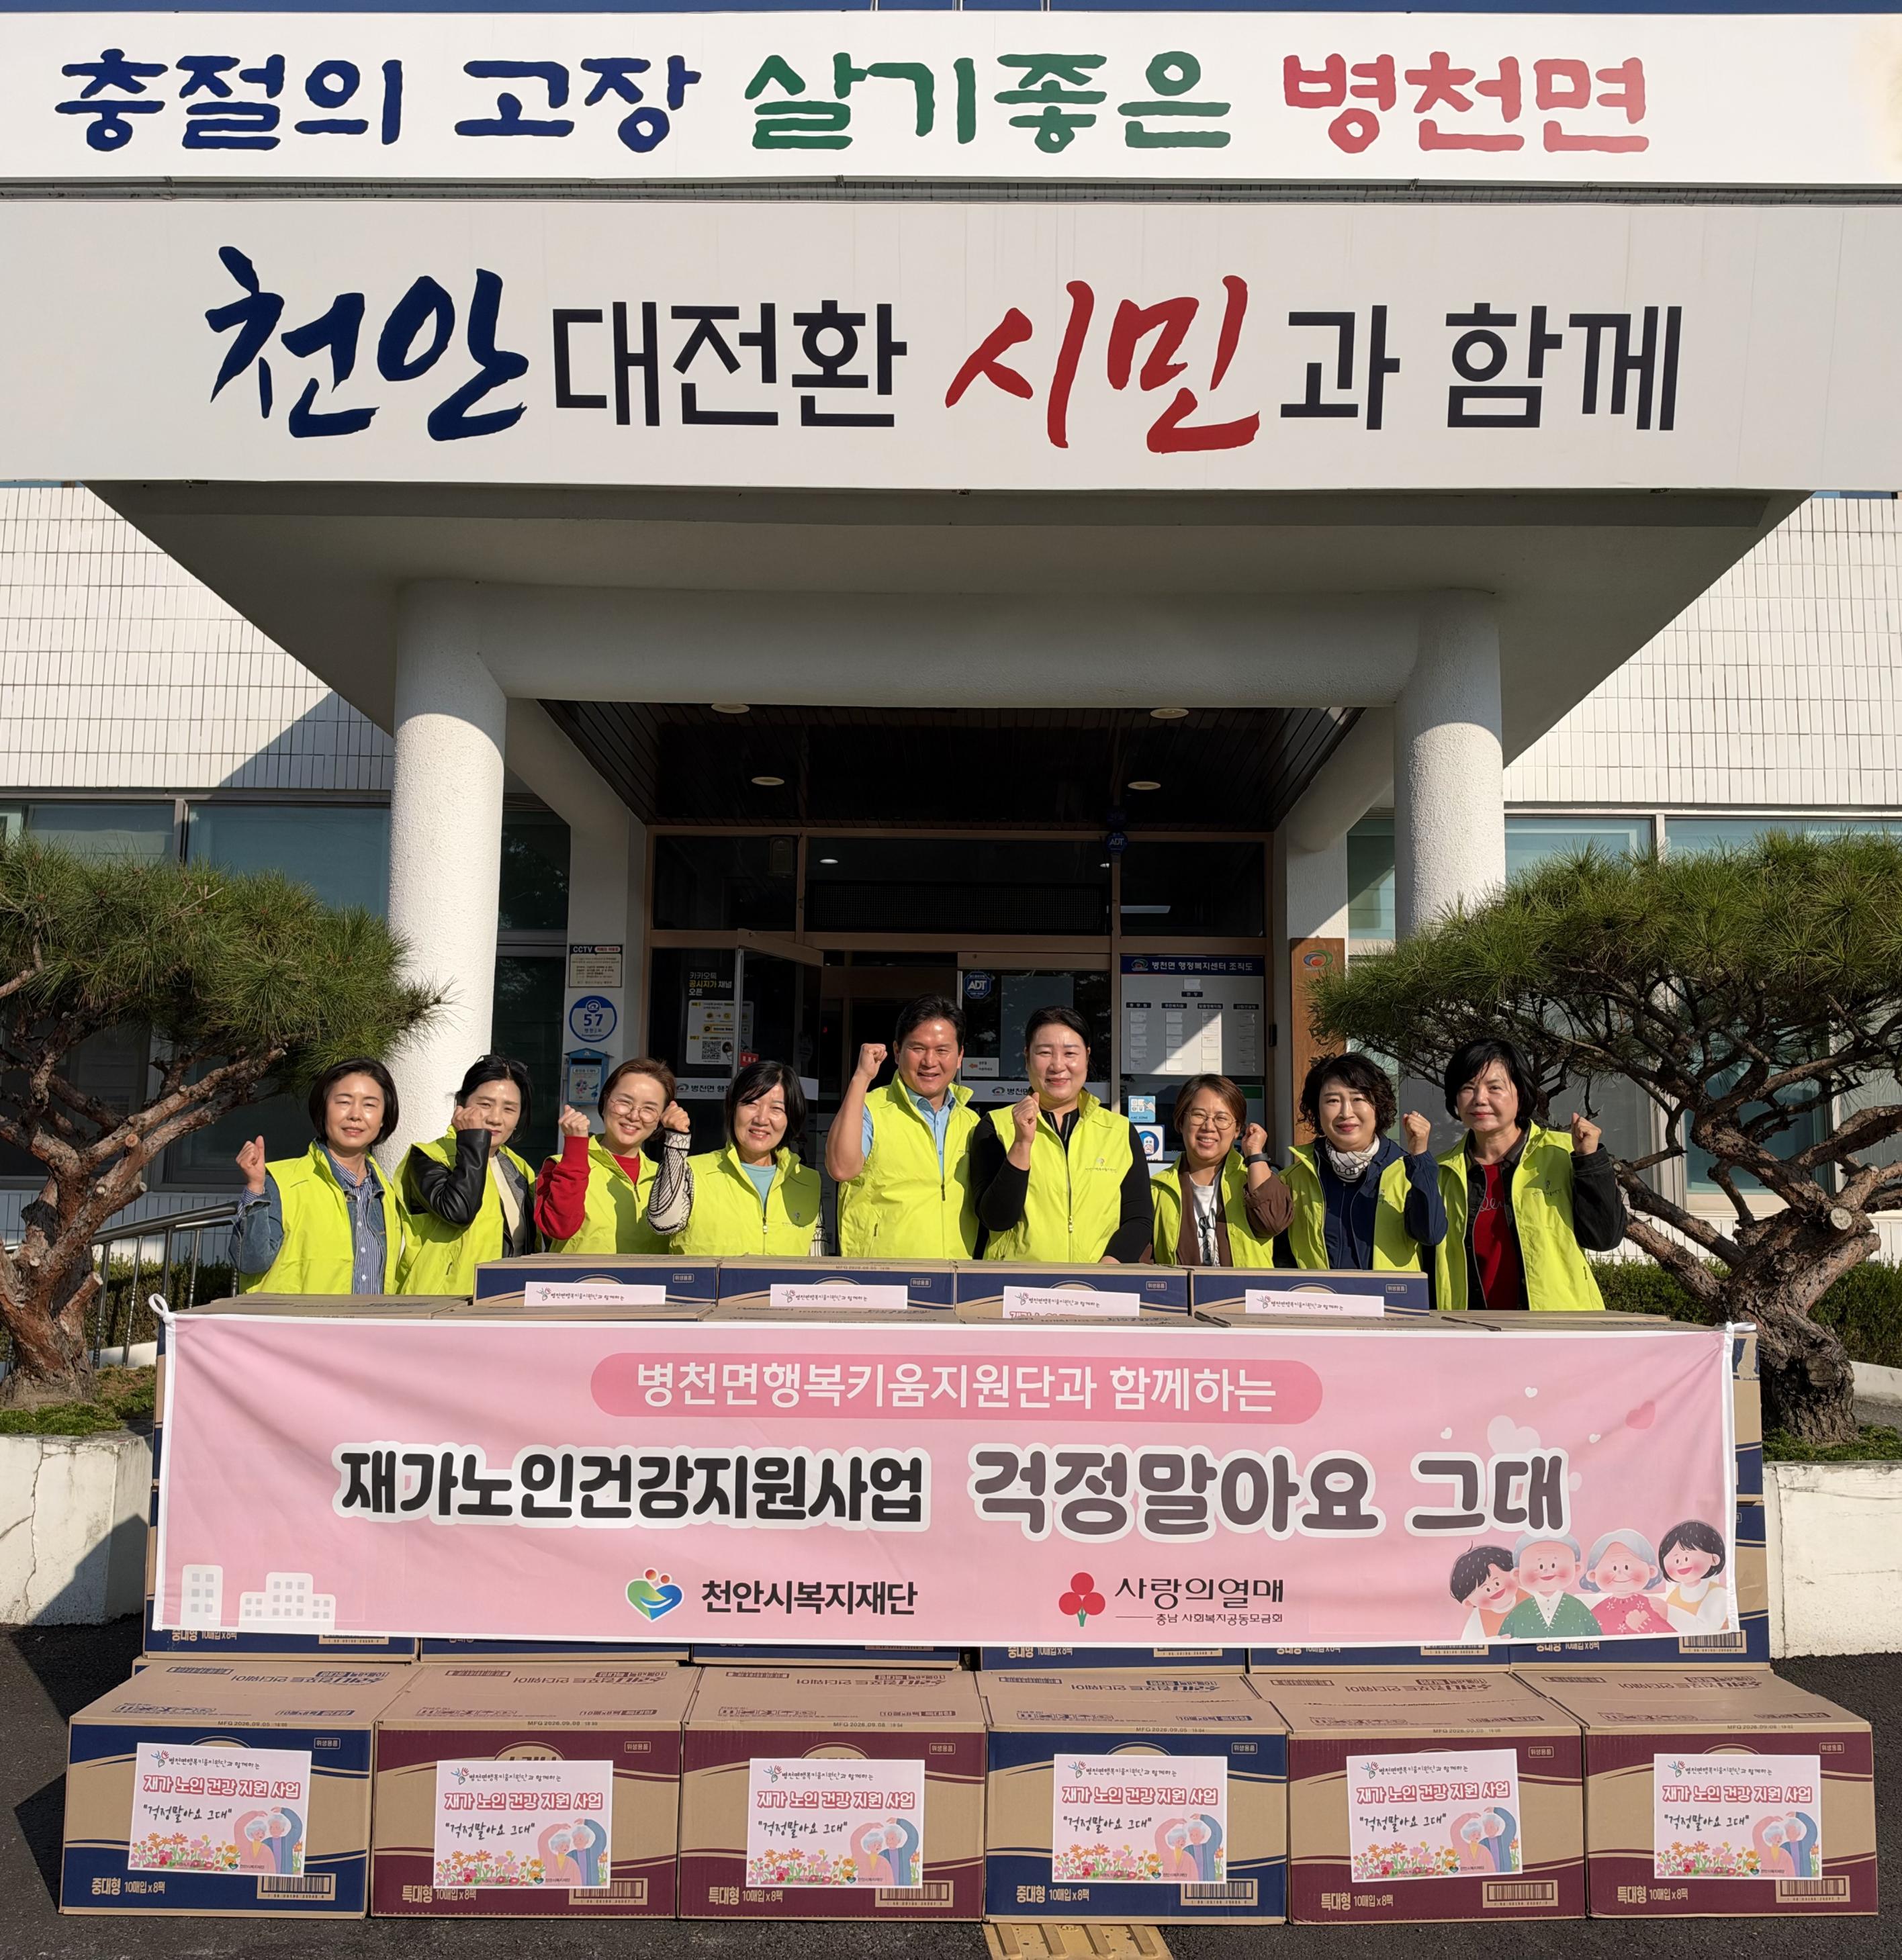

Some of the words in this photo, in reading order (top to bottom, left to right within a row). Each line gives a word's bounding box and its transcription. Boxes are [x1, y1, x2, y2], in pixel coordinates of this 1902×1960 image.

[55, 49, 403, 152] 충절의
[455, 56, 702, 153] 고장
[745, 52, 1231, 154] 살기좋은
[1284, 52, 1643, 154] 병천면
[945, 275, 1400, 455] 시민과
[1446, 303, 1682, 431] 함께
[1110, 838, 1124, 846] ADT
[689, 972, 717, 980] 카카오톡
[1152, 962, 1175, 970] 병천면
[1178, 962, 1226, 971] 행정복지센터
[1229, 962, 1253, 971] 조직도
[688, 980, 717, 988] 공시지가
[718, 980, 732, 988] 채널
[688, 988, 703, 996] 오픈
[967, 980, 987, 990] ADT
[584, 1013, 604, 1027] 57
[638, 1362, 1097, 1409] 병천면행복키움지원단과
[1109, 1366, 1276, 1412] 함께하는
[341, 1450, 922, 1522] 재가노인건강지원사업
[975, 1451, 1378, 1535] 걱정말아요
[1412, 1454, 1563, 1530] 그대
[702, 1580, 918, 1615] 천안시복지재단
[1115, 1578, 1283, 1610] 사랑의열매
[1156, 1614, 1178, 1626] 충남
[1182, 1613, 1283, 1626] 사회복지공동모금회
[316, 1739, 338, 1747] 위생용품
[1233, 1744, 1255, 1753] 위생용품
[142, 1775, 172, 1793] 재가
[175, 1777, 204, 1795] 노인
[207, 1778, 236, 1797] 건강
[238, 1780, 268, 1798] 지원
[271, 1781, 301, 1800] 사업
[1062, 1786, 1091, 1804] 재가
[1093, 1787, 1123, 1804] 노인
[1126, 1787, 1155, 1804] 건강
[1158, 1788, 1187, 1805] 지원
[1189, 1788, 1218, 1806] 사업
[1357, 1786, 1386, 1804] 재가
[1388, 1785, 1416, 1803] 노인
[1419, 1783, 1448, 1802] 건강
[1451, 1782, 1480, 1800] 지원
[1482, 1781, 1510, 1798] 사업
[1662, 1785, 1691, 1802] 재가
[1693, 1785, 1721, 1802] 노인
[1724, 1786, 1752, 1803] 건강
[1754, 1786, 1782, 1803] 지원
[1785, 1786, 1813, 1804] 사업
[445, 1792, 473, 1810] 재가
[477, 1792, 506, 1810] 노인
[509, 1792, 538, 1810] 건강
[541, 1792, 570, 1810] 지원
[573, 1792, 603, 1810] 사업
[758, 1791, 787, 1808] 재가
[790, 1791, 819, 1808] 노인
[821, 1791, 851, 1809] 건강
[854, 1791, 882, 1809] 지원
[886, 1791, 915, 1810] 사업
[91, 1877, 121, 1896] 중대형
[124, 1880, 148, 1894] 10매입
[402, 1885, 433, 1904] 특대형
[436, 1888, 459, 1901] 10매입
[709, 1886, 739, 1905] 특대형
[742, 1889, 765, 1902] 10매입
[1016, 1885, 1046, 1903] 중대형
[1048, 1888, 1071, 1901] 10매입
[1617, 1885, 1647, 1904] 특대형
[1649, 1889, 1671, 1901] 10매입
[1321, 1892, 1351, 1910] 특대형
[1353, 1895, 1376, 1907] 10매입
